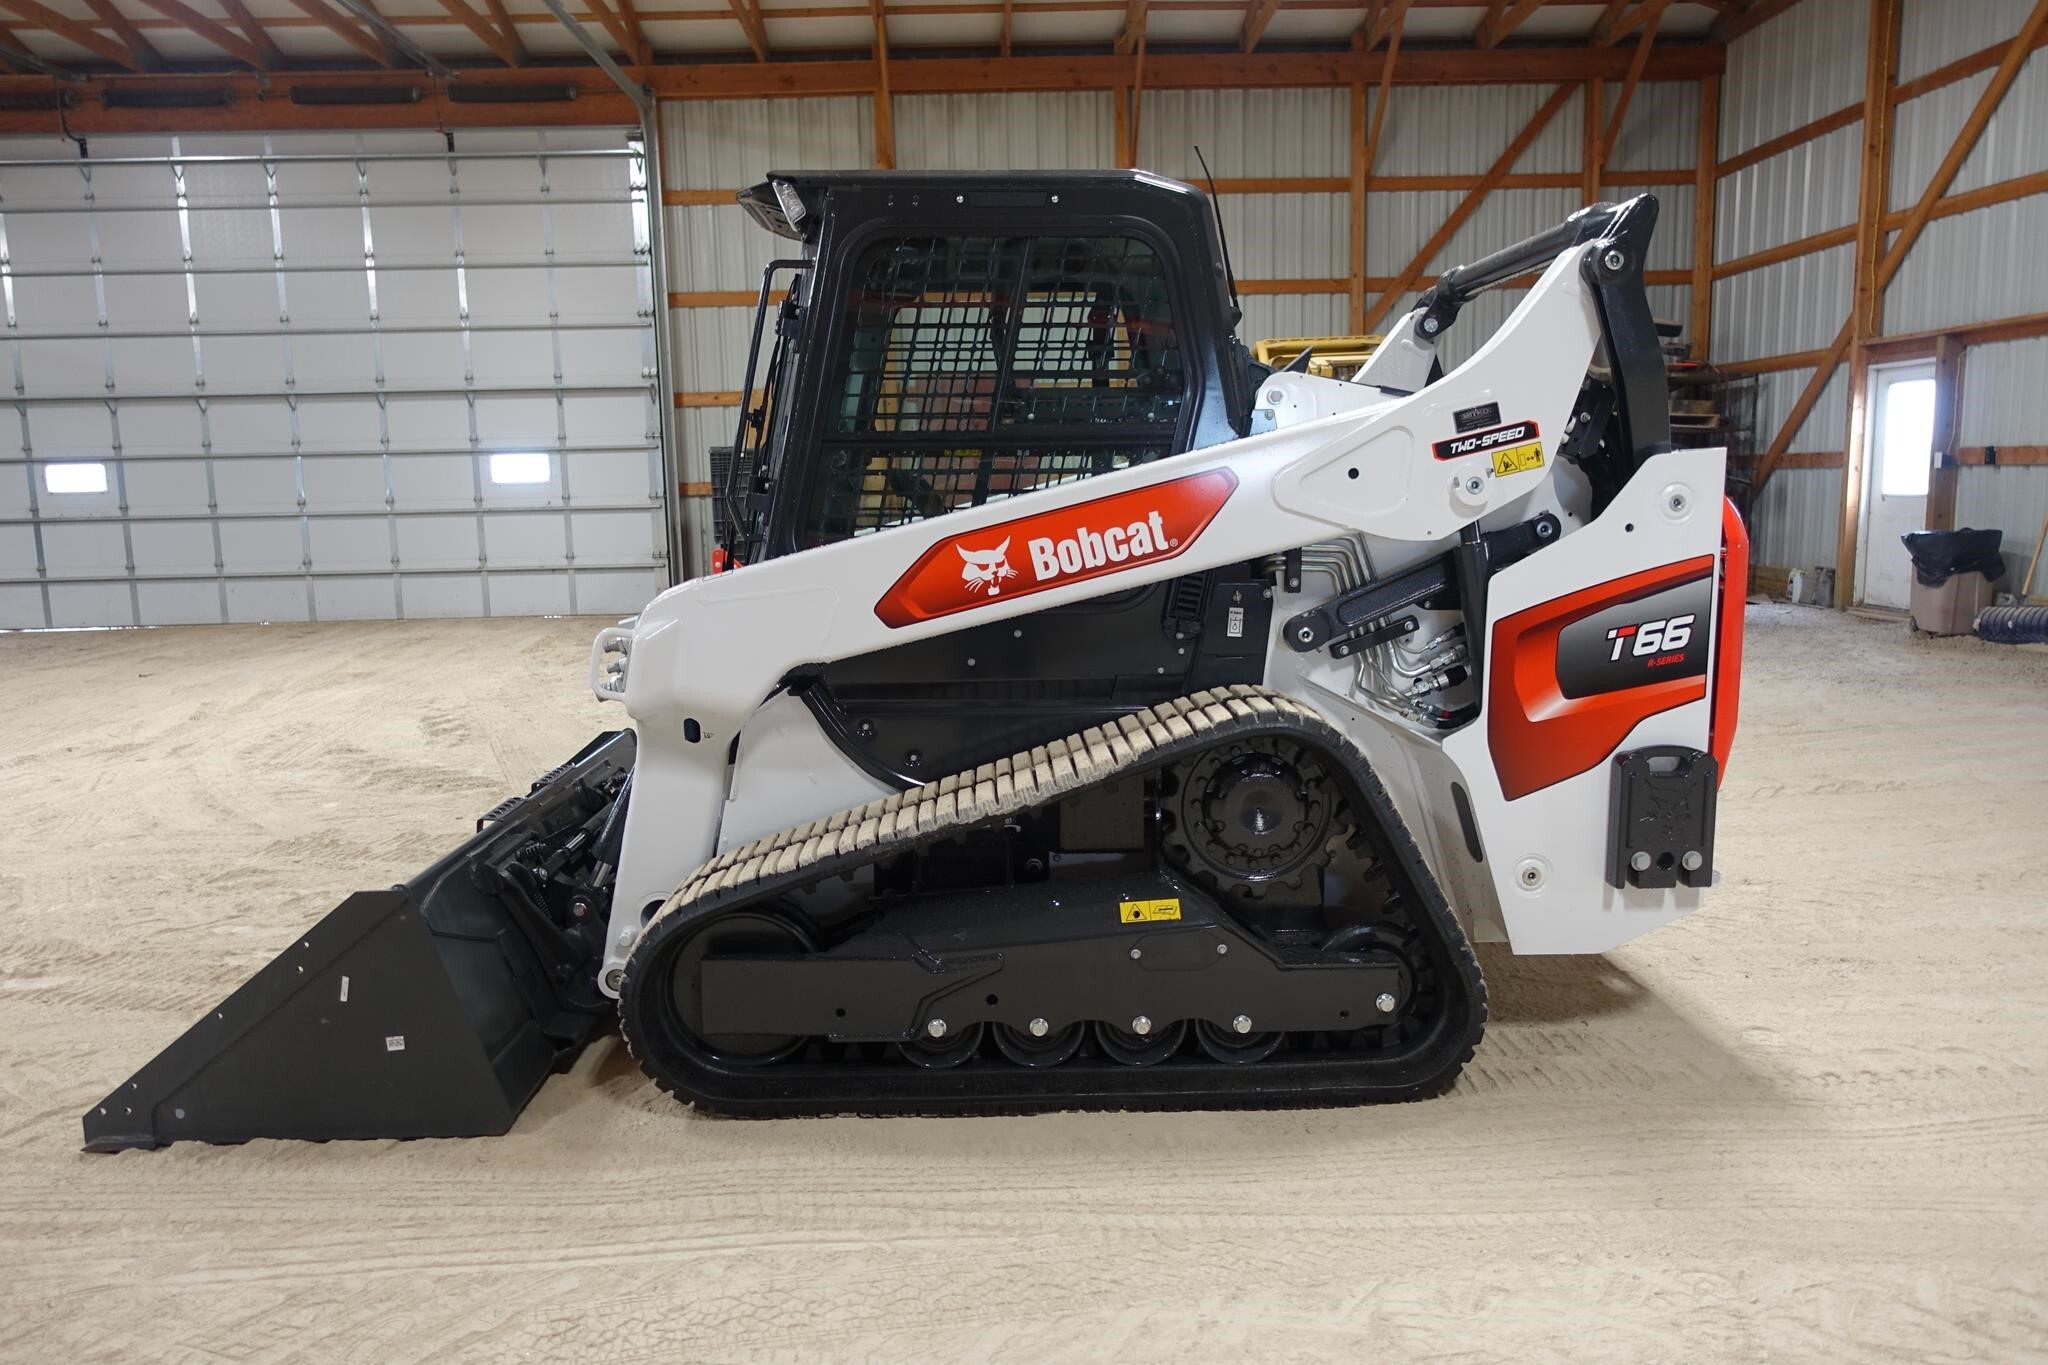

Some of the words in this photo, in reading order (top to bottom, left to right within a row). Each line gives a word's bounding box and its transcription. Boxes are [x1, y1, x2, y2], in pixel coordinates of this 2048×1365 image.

[1450, 427, 1525, 454] TWO-SPEED
[1028, 511, 1169, 581] Bobcat
[1606, 614, 1695, 661] T66
[1647, 653, 1685, 668] R-SERIES
